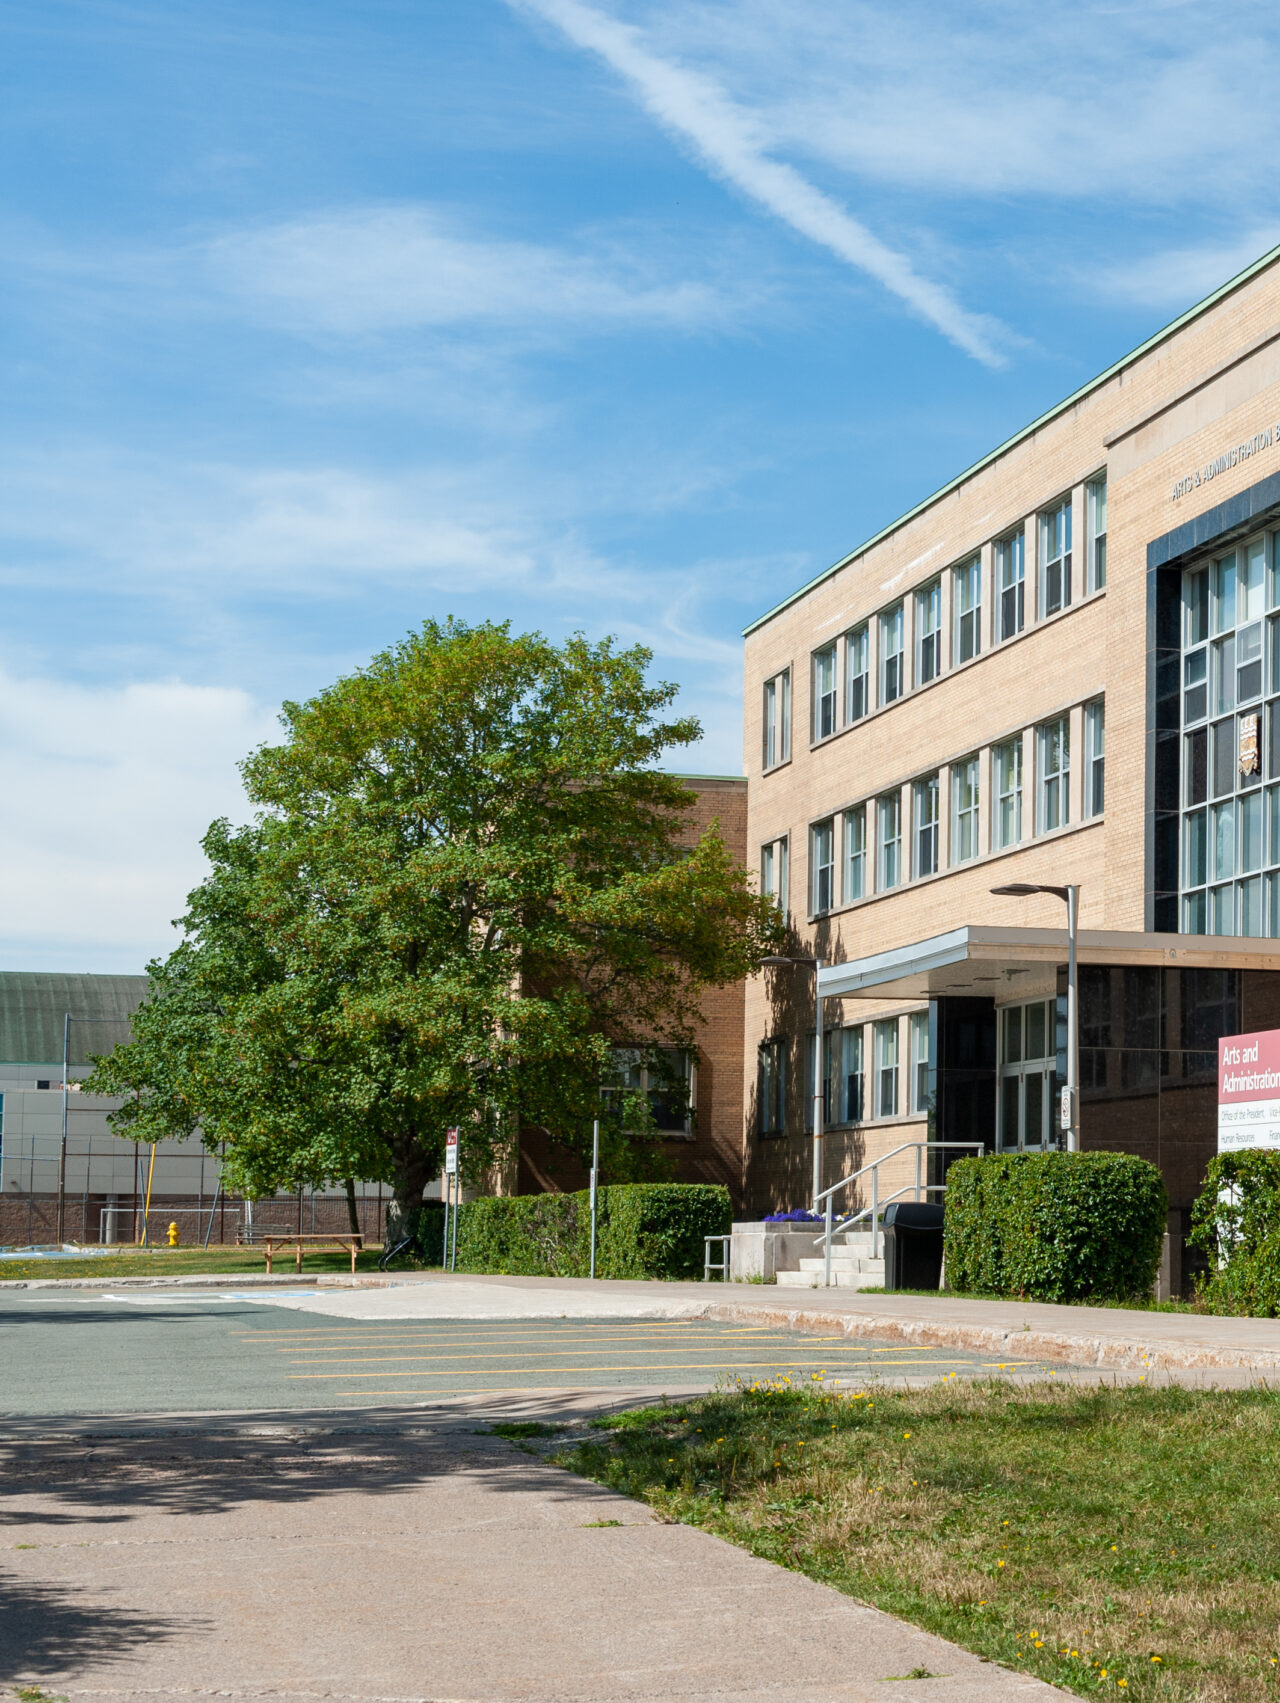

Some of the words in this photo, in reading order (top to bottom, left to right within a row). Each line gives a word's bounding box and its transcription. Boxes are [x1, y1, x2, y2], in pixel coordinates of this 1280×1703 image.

[1172, 475, 1192, 500] ARTS
[1193, 469, 1201, 488] &
[1202, 428, 1273, 483] ADMINISTRATION
[1222, 1046, 1240, 1066] Arts
[1242, 1040, 1259, 1063] and
